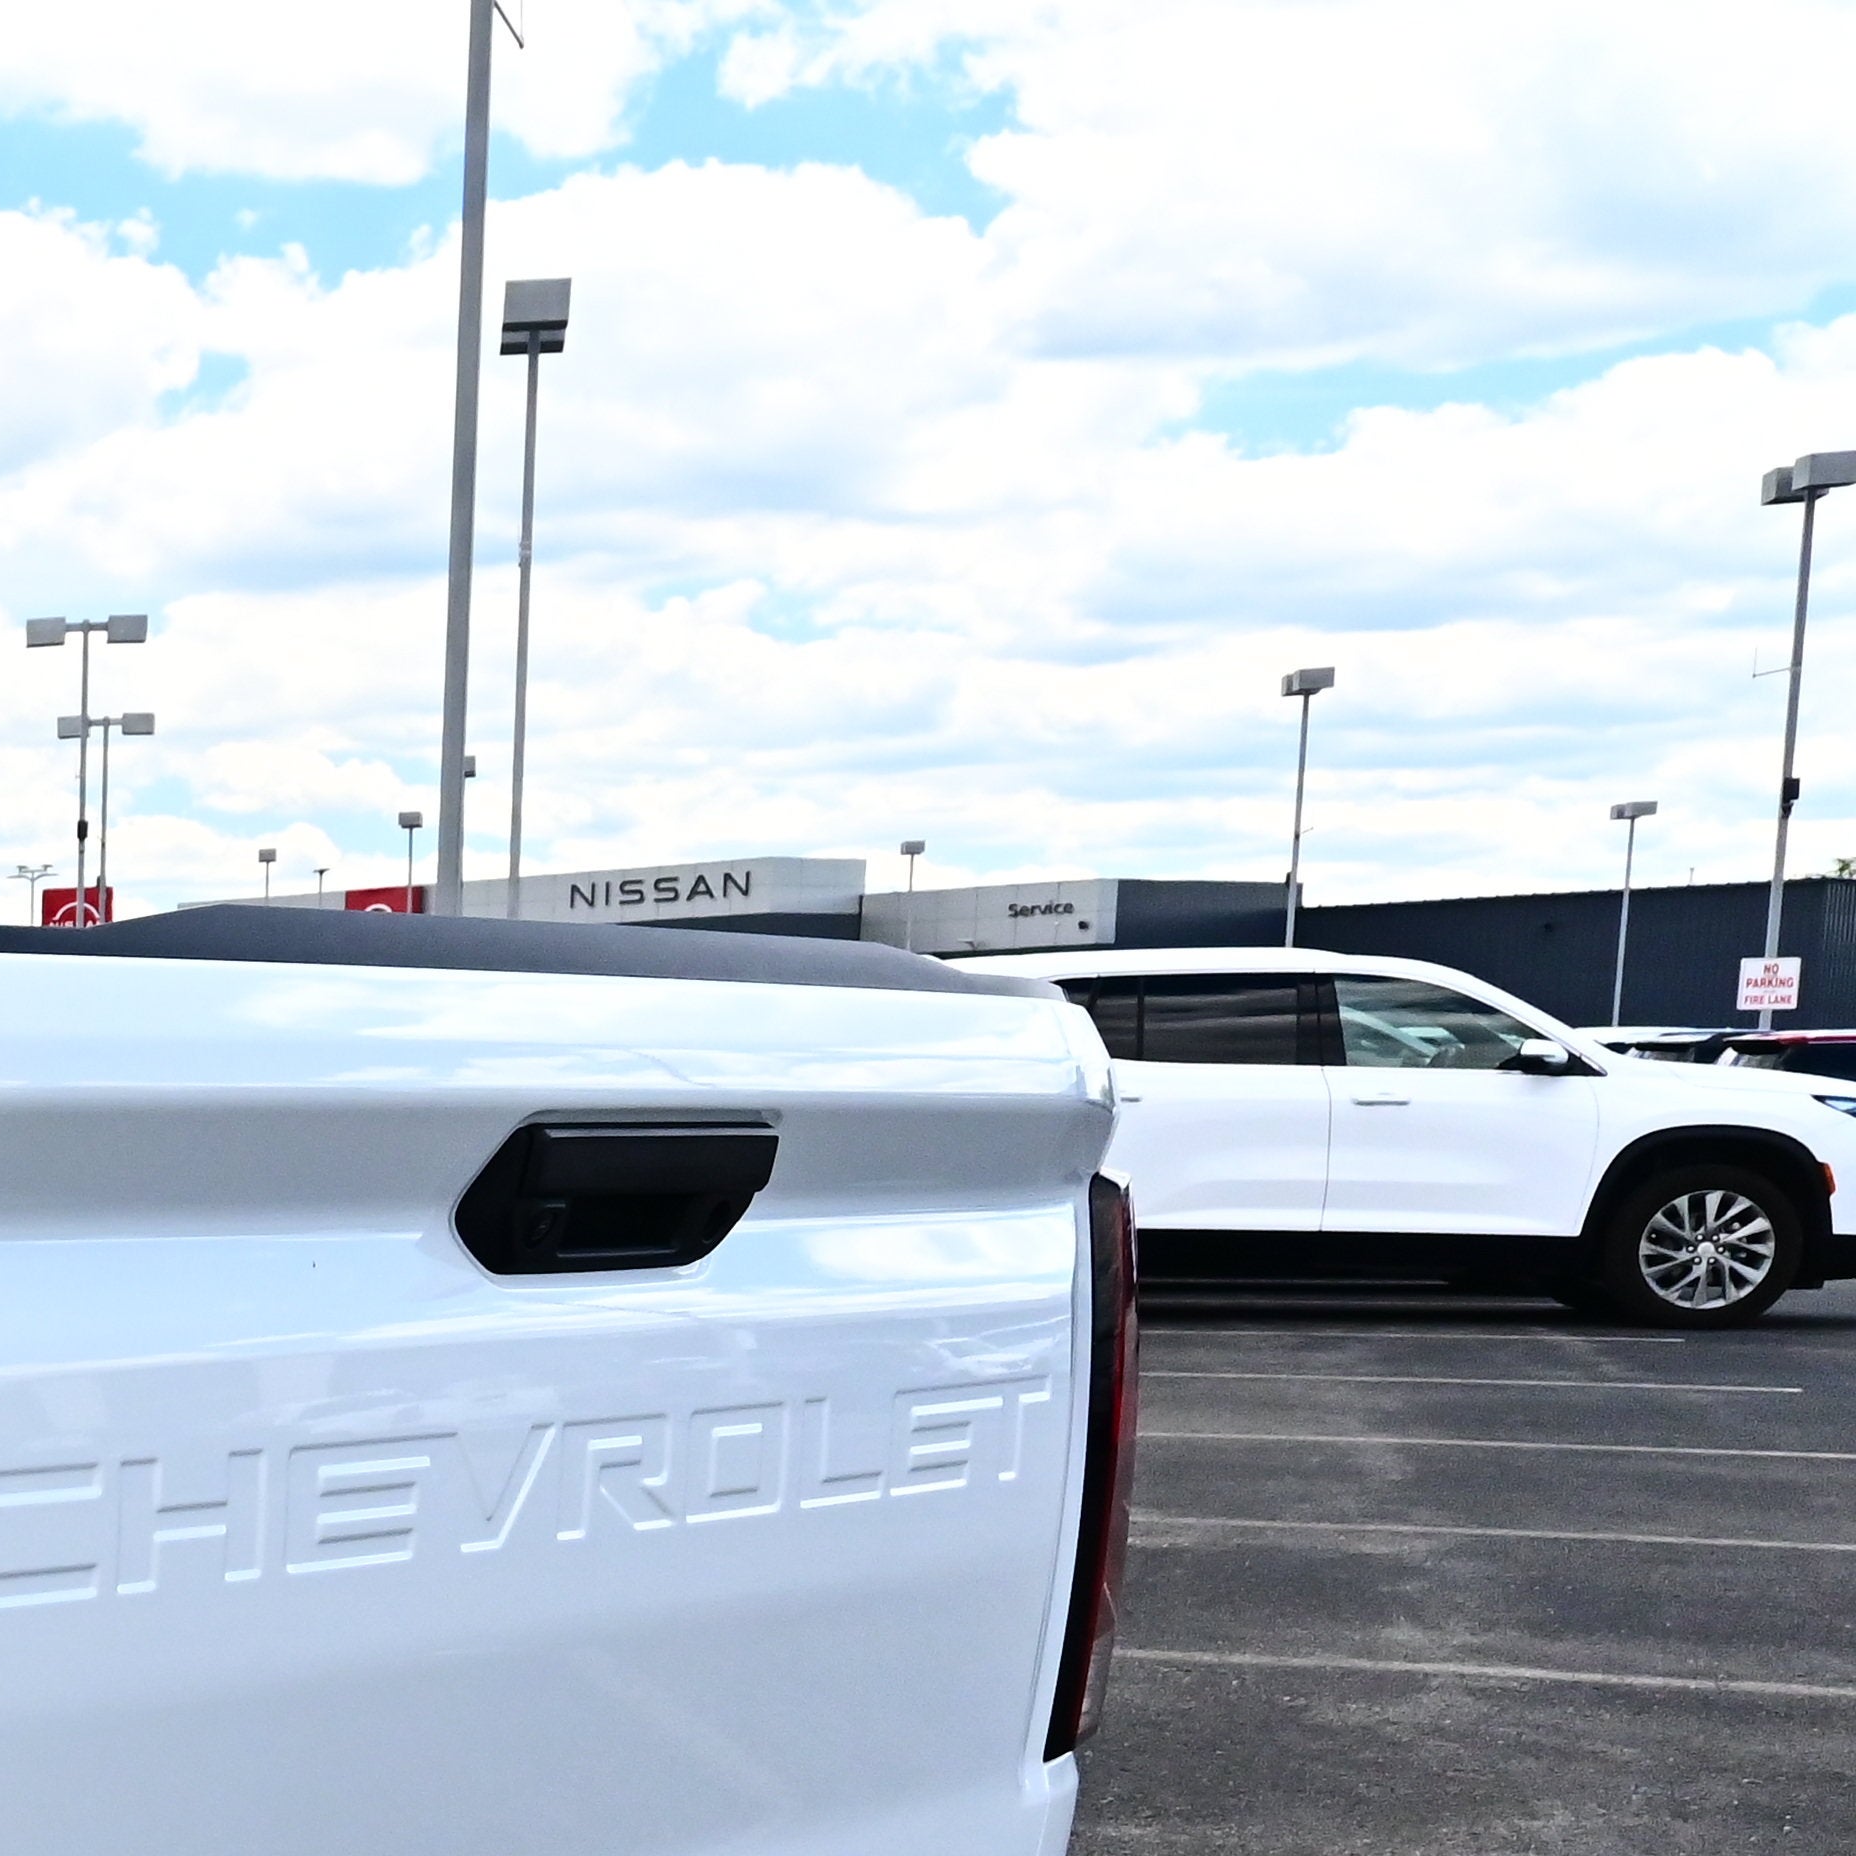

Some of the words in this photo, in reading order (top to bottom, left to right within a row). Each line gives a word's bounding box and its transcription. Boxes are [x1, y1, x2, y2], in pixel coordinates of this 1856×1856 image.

[570, 870, 752, 909] NISSAN
[1008, 900, 1075, 918] Service
[1763, 963, 1779, 975] NO
[1746, 977, 1794, 988] PARKING
[1744, 995, 1765, 1005] FIRE
[1768, 994, 1792, 1005] LANE
